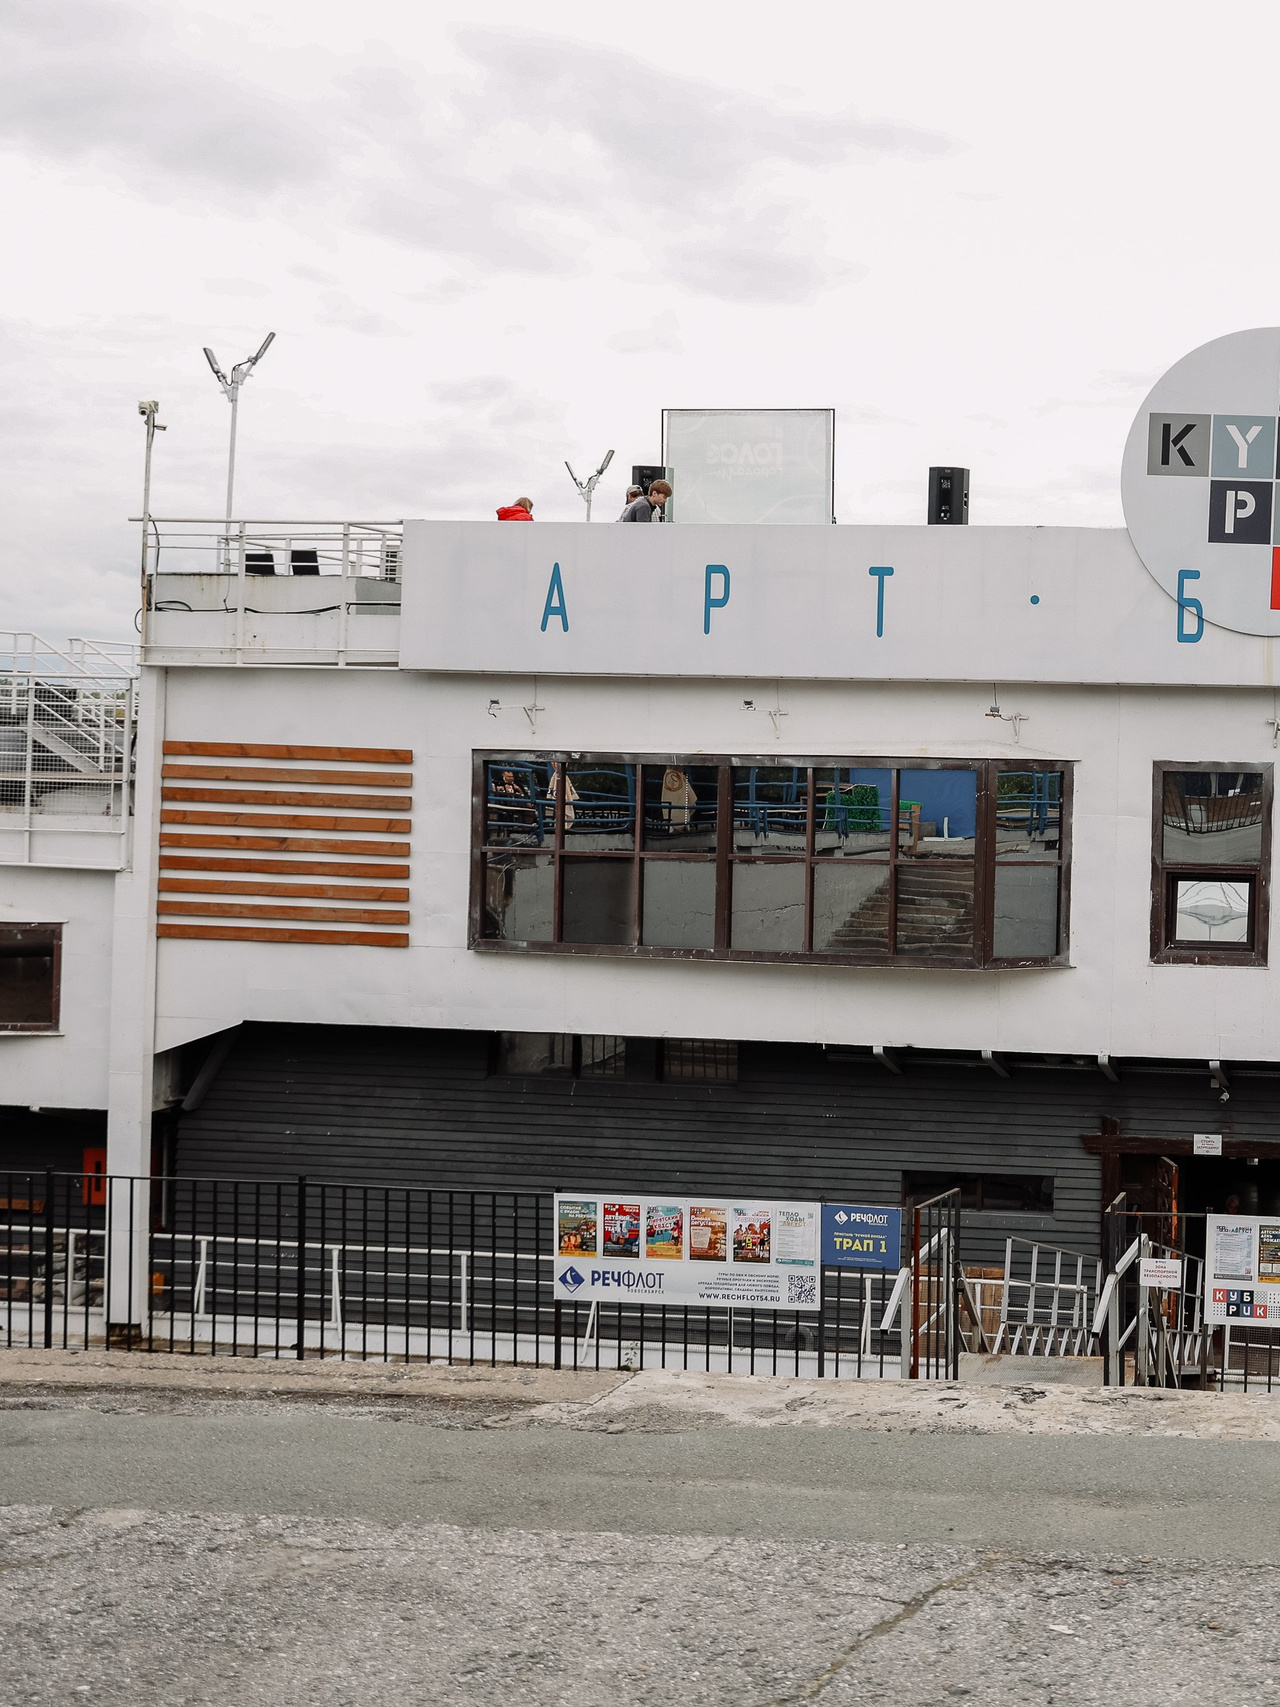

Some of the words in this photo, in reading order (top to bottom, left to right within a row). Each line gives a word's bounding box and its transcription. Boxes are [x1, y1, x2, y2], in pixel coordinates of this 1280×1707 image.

[850, 1213, 888, 1224] РЕЧФЛОТ
[833, 1238, 874, 1252] ТРАП
[880, 1240, 887, 1253] 1
[591, 1269, 665, 1289] РЕЧФЛОТ
[698, 1293, 781, 1302] WWW.RECHFLOT54.RU
[1216, 1291, 1252, 1302] КУБ
